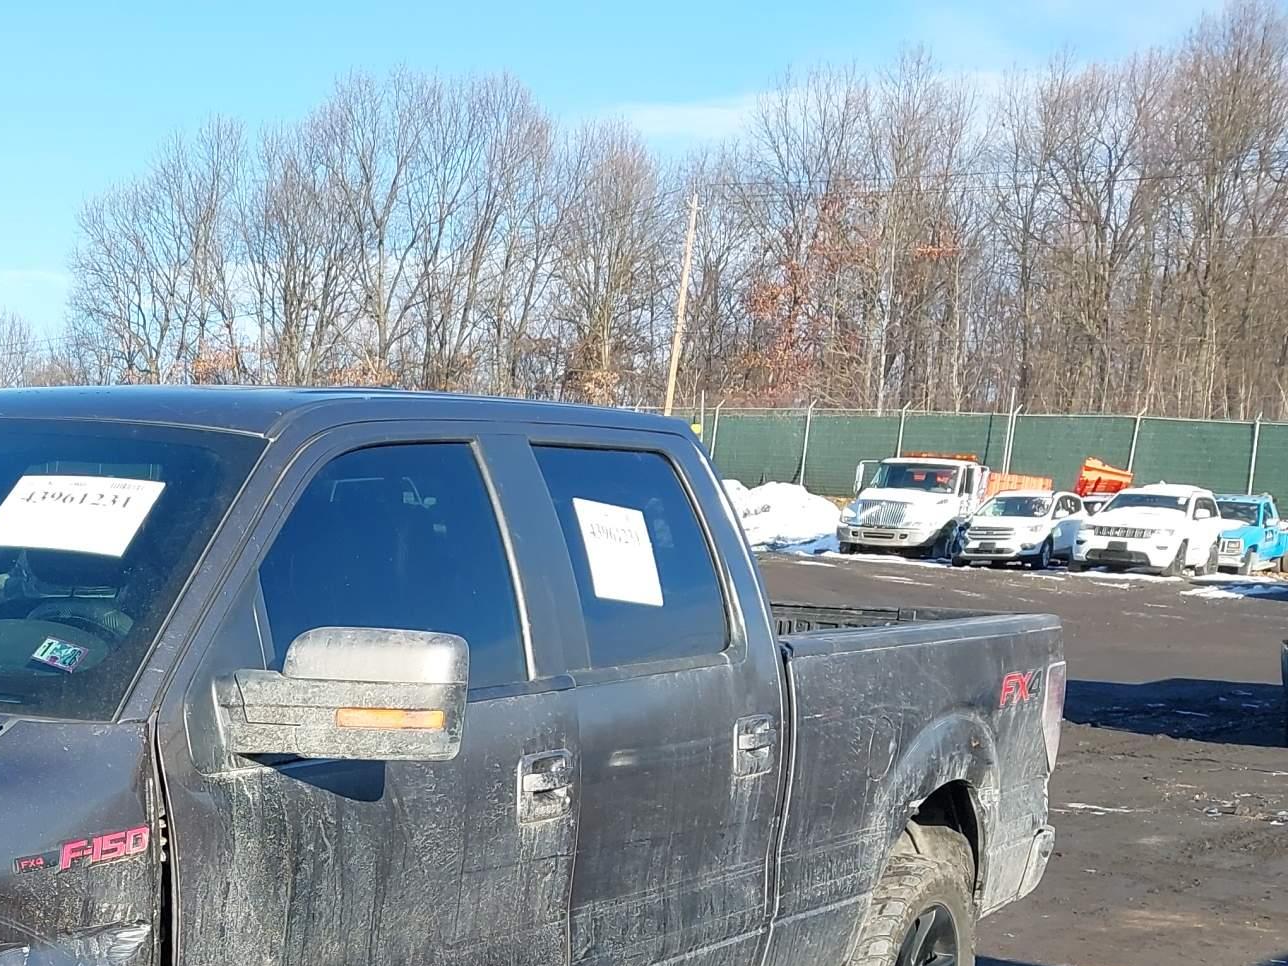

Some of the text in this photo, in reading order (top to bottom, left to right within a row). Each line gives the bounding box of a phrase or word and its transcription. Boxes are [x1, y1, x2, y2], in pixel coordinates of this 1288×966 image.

[20, 489, 132, 509] 43961231
[999, 668, 1043, 708] FX4
[60, 824, 150, 871] F-150
